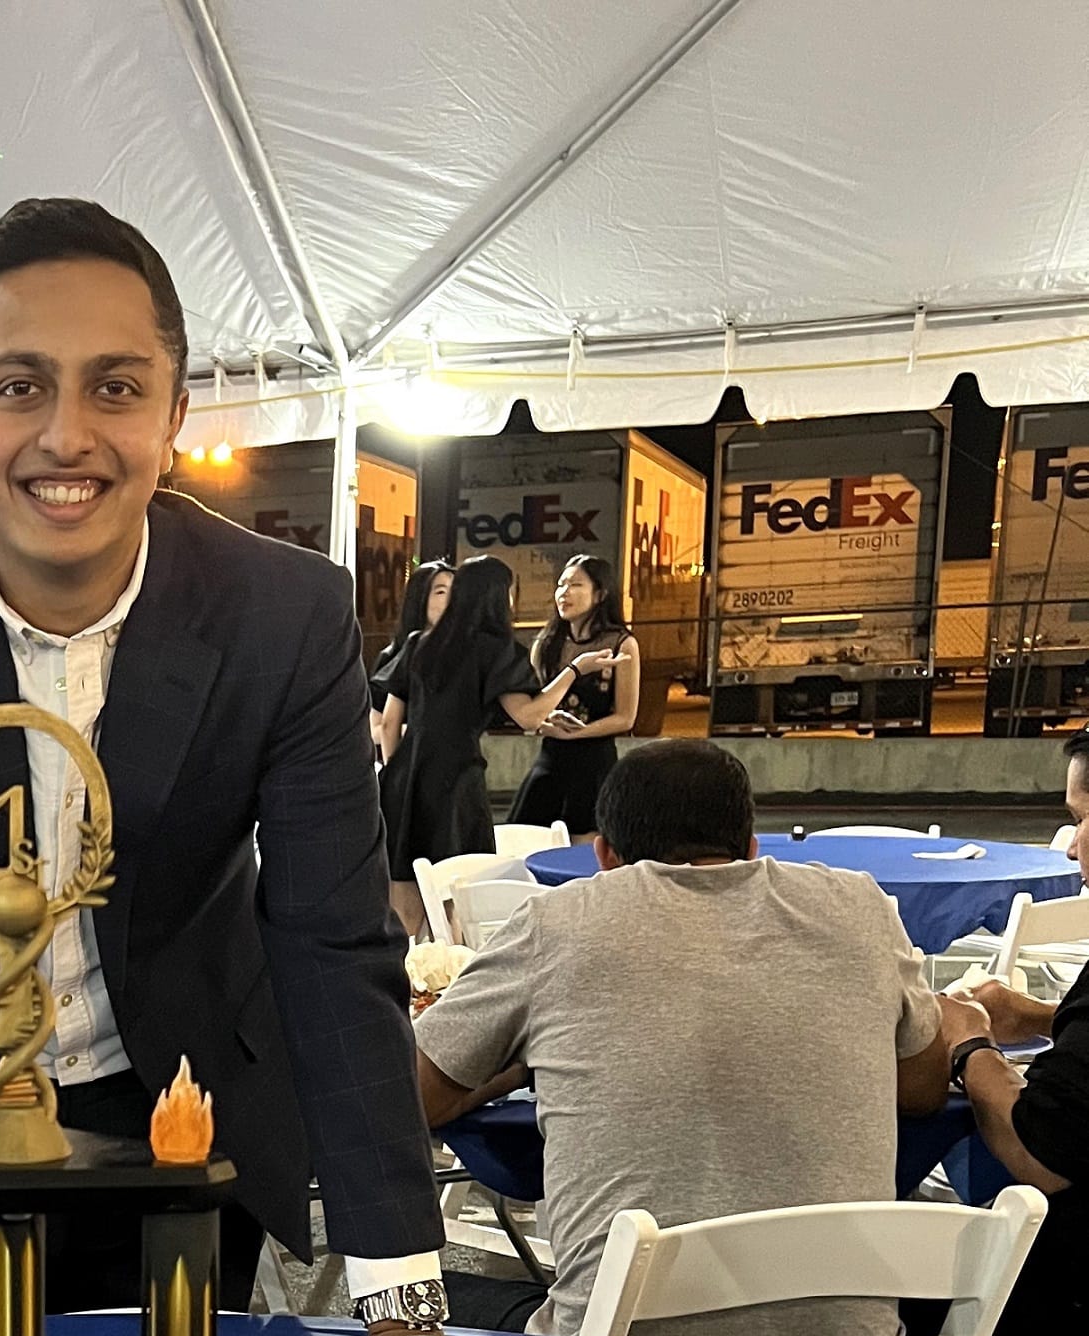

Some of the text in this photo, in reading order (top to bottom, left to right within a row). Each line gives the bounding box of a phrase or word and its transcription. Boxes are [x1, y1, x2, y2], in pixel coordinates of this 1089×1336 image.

[740, 475, 915, 535] FedEx
[838, 531, 901, 552] Freight
[732, 589, 794, 608] 2890202
